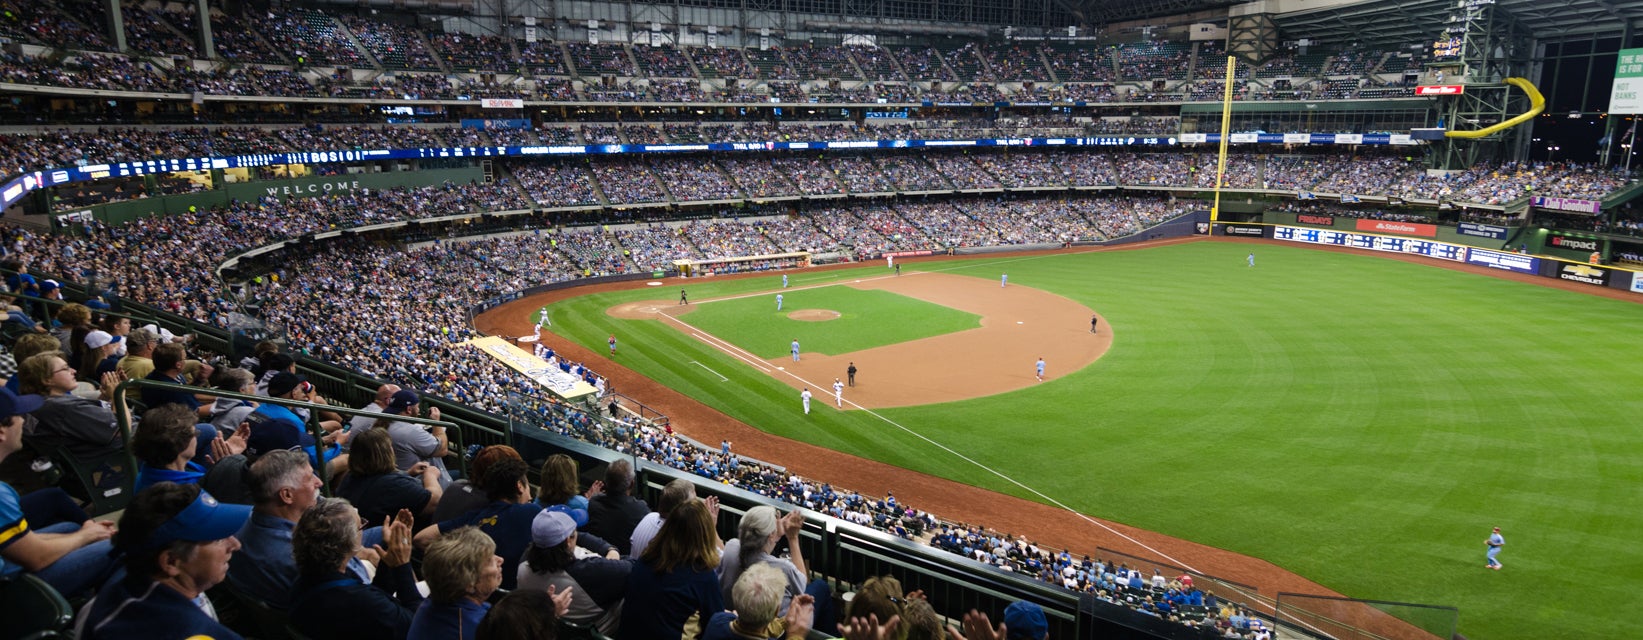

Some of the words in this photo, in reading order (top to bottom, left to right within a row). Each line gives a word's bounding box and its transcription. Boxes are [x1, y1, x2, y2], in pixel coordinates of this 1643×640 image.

[1621, 55, 1634, 64] THE
[1619, 65, 1627, 73] IS
[1628, 64, 1642, 73] FOR
[1616, 83, 1630, 91] NOT
[1615, 92, 1637, 100] BANKS
[492, 120, 511, 129] PNC
[266, 180, 360, 196] WELCOME
[1544, 197, 1560, 209] Club
[1561, 198, 1594, 213] Goodwill
[1297, 214, 1333, 225] FRIDAYS
[1559, 237, 1597, 250] impact
[1561, 273, 1604, 285] CHEVROLET
